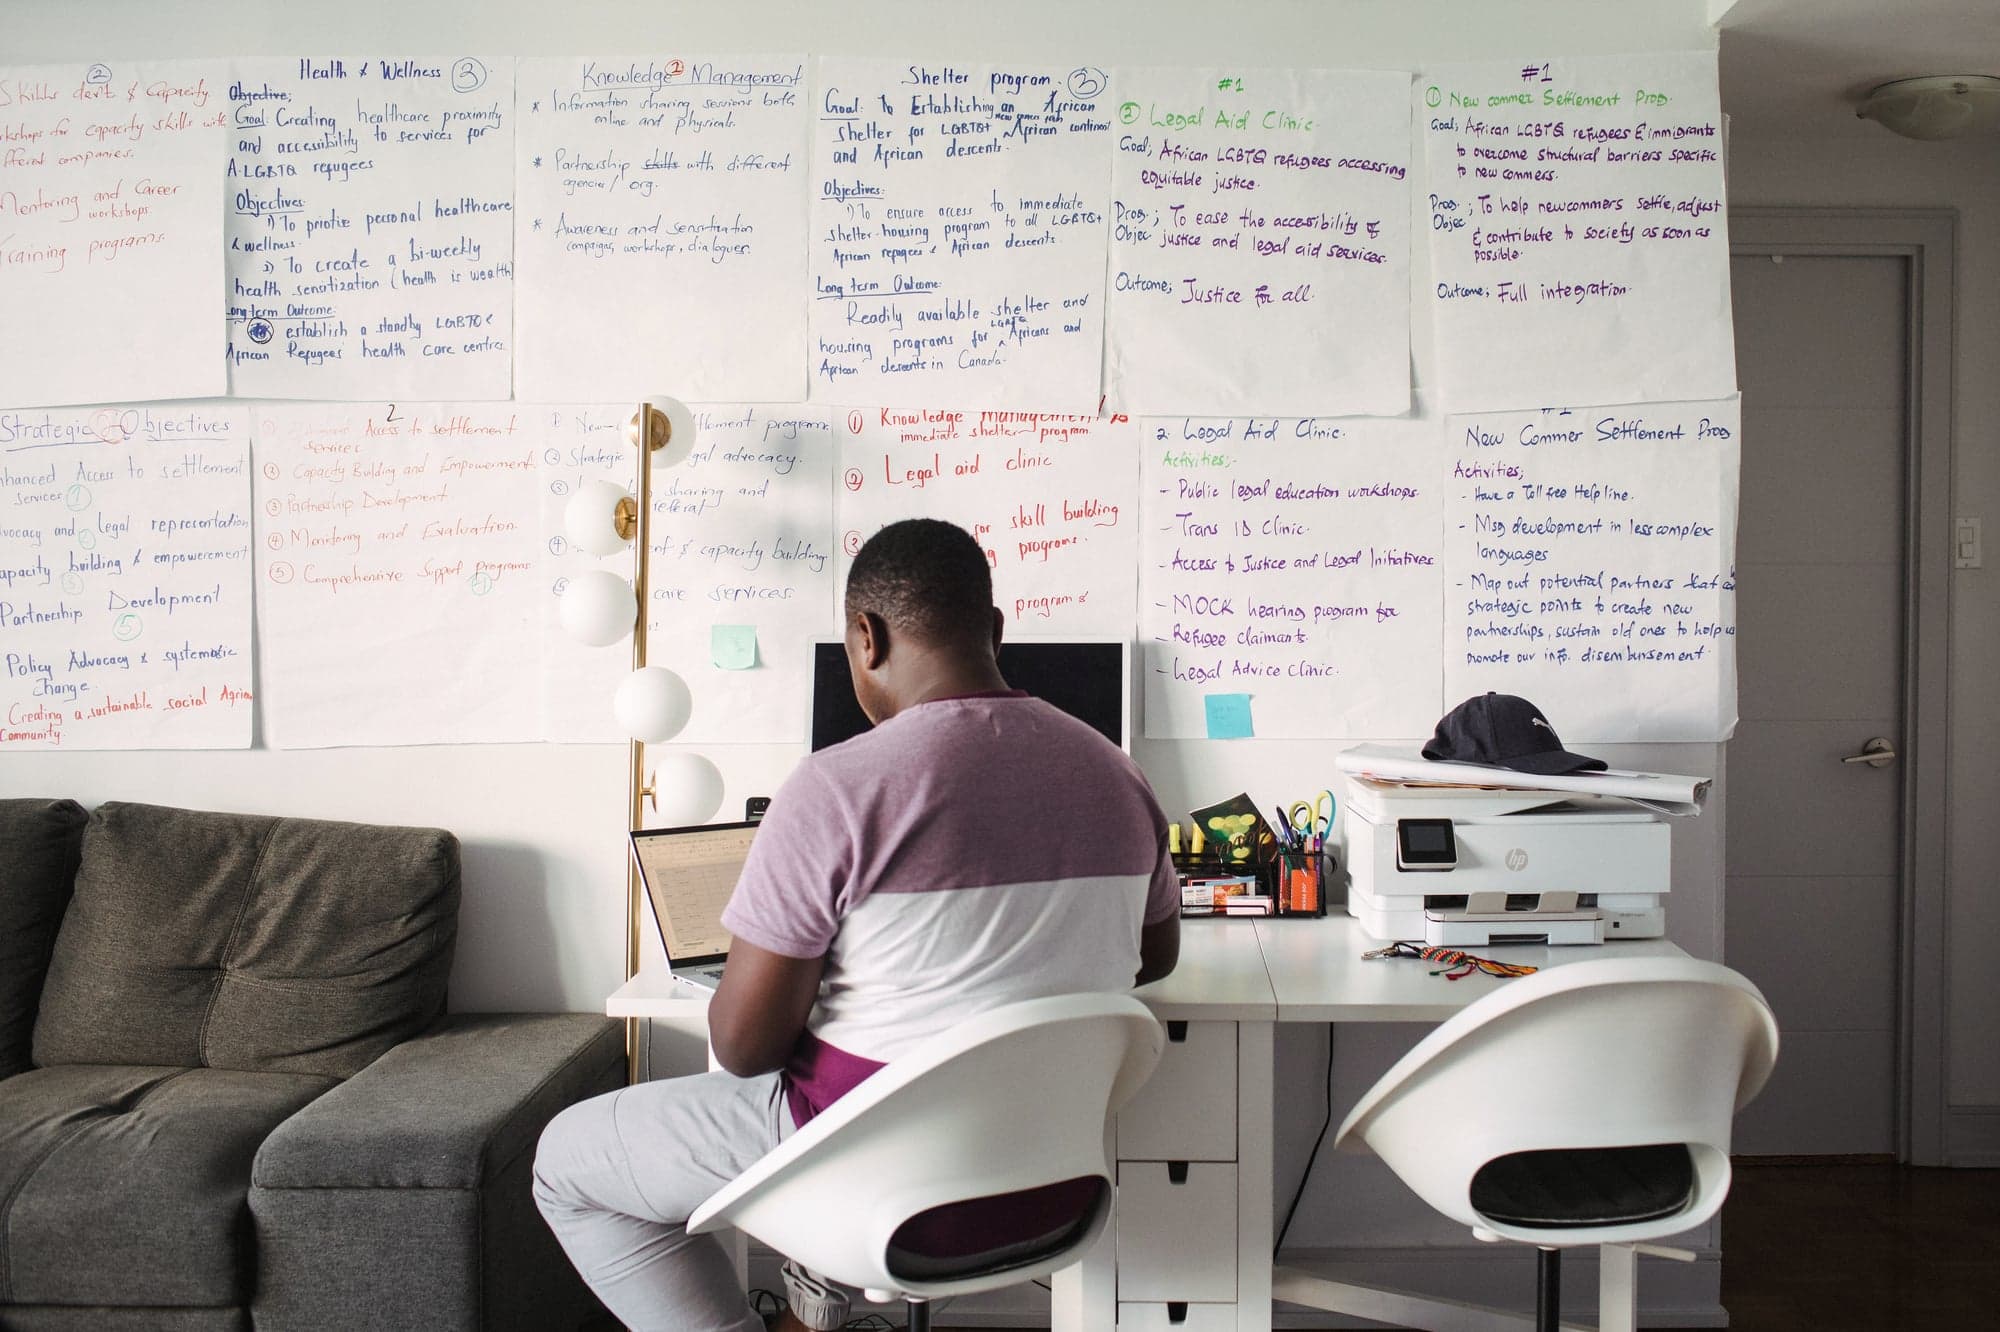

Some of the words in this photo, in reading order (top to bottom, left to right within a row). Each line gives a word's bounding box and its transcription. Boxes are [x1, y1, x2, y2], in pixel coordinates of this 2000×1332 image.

[300, 59, 347, 80] Health
[381, 60, 441, 80] Wellness
[583, 62, 672, 92] Knowledge
[692, 63, 801, 94] Management
[902, 66, 969, 86] Shelter
[1521, 63, 1552, 82] #1
[1218, 78, 1244, 92] #1
[553, 90, 628, 111] Information
[1044, 91, 1095, 119] African
[1450, 91, 1479, 108] New
[1543, 89, 1620, 106] Settlement
[276, 106, 336, 133] Creating
[358, 98, 429, 124] healthcare
[442, 102, 502, 130] proximity
[1150, 103, 1204, 131] Legal
[1215, 111, 1250, 129] Aid
[239, 136, 262, 154] and
[374, 125, 387, 142] to
[909, 126, 924, 145] for
[1465, 116, 1510, 137] African
[1573, 127, 1630, 143] refugees
[1648, 122, 1715, 140] immigrants
[727, 154, 791, 172] different
[834, 148, 857, 164] and
[1159, 139, 1208, 161] African
[1217, 149, 1267, 164] LGBTQ
[1274, 153, 1331, 168] refugees
[1338, 159, 1407, 180] accessing
[1474, 146, 1528, 160] overcome
[1537, 148, 1600, 162] structural
[1608, 146, 1662, 162] barriers
[1669, 148, 1717, 162] specific
[313, 160, 374, 181] refugees
[1141, 170, 1202, 189] equitable
[95, 179, 123, 202] and
[992, 190, 1003, 212] to
[1020, 193, 1083, 214] immediate
[435, 199, 512, 217] healthcare
[1170, 205, 1186, 226] To
[1196, 213, 1228, 224] ease
[1240, 207, 1265, 227] the
[1478, 194, 1492, 215] To
[1500, 199, 1529, 214] help
[628, 215, 661, 235] and
[944, 221, 990, 242] program
[1006, 214, 1015, 227] to
[1025, 214, 1037, 226] all
[1487, 228, 1553, 244] contribute
[1584, 222, 1635, 243] society
[316, 249, 370, 270] create
[410, 237, 481, 262] bi-weekly
[1160, 229, 1200, 248] justice
[1213, 233, 1240, 250] and
[1253, 232, 1290, 256] legal
[1296, 244, 1321, 257] aid
[235, 278, 281, 296] health
[1182, 279, 1241, 304] Justice
[1498, 282, 1527, 302] Full
[848, 301, 903, 331] Readily
[918, 299, 979, 321] available
[1063, 294, 1089, 308] and
[363, 336, 405, 357] health
[894, 335, 953, 357] programs
[973, 330, 988, 348] for
[880, 407, 963, 434] Knowledge
[1184, 418, 1233, 443] Legal
[1244, 420, 1279, 442] Aid
[1465, 425, 1504, 447] New
[1596, 417, 1686, 441] Settlement
[128, 456, 144, 478] to
[160, 454, 245, 479] settlement
[885, 453, 940, 489] Legal
[955, 454, 980, 477] aid
[1006, 448, 1052, 471] clinic
[666, 479, 723, 506] sharing
[738, 480, 769, 497] and
[1179, 479, 1219, 498] Public
[1232, 480, 1271, 501] legal
[1275, 483, 1339, 499] education
[1546, 487, 1567, 500] free
[1011, 504, 1045, 529] skill
[1064, 499, 1118, 527] building
[1176, 512, 1218, 537] Trans
[55, 517, 76, 536] and
[1512, 516, 1602, 535] development
[1611, 521, 1621, 531] in
[1630, 519, 1652, 535] less
[1656, 523, 1714, 537] complex
[69, 550, 121, 575] building
[701, 542, 763, 572] capacity
[1172, 548, 1218, 571] Access
[1242, 555, 1287, 573] Justice
[1295, 553, 1318, 567] and
[1325, 551, 1362, 567] Legal
[1371, 548, 1434, 569] Initiatives
[1476, 542, 1549, 566] languages
[1471, 573, 1501, 592] Map
[1507, 575, 1529, 588] out
[1541, 571, 1603, 591] potential
[1611, 577, 1674, 596] partners
[109, 584, 220, 615] Development
[1173, 594, 1234, 616] MOCK
[1249, 596, 1306, 620] hearing
[1468, 599, 1533, 617] strategic
[1611, 601, 1652, 615] create
[1663, 602, 1692, 614] new
[1173, 624, 1226, 648] Refugee
[1612, 621, 1635, 636] old
[1641, 626, 1665, 636] ones
[7, 653, 52, 678] Policy
[1173, 657, 1221, 684] Legal
[1232, 661, 1281, 676] Advice
[9, 703, 62, 726] Creating
[164, 686, 207, 711] social
[1506, 848, 1528, 871] hp
